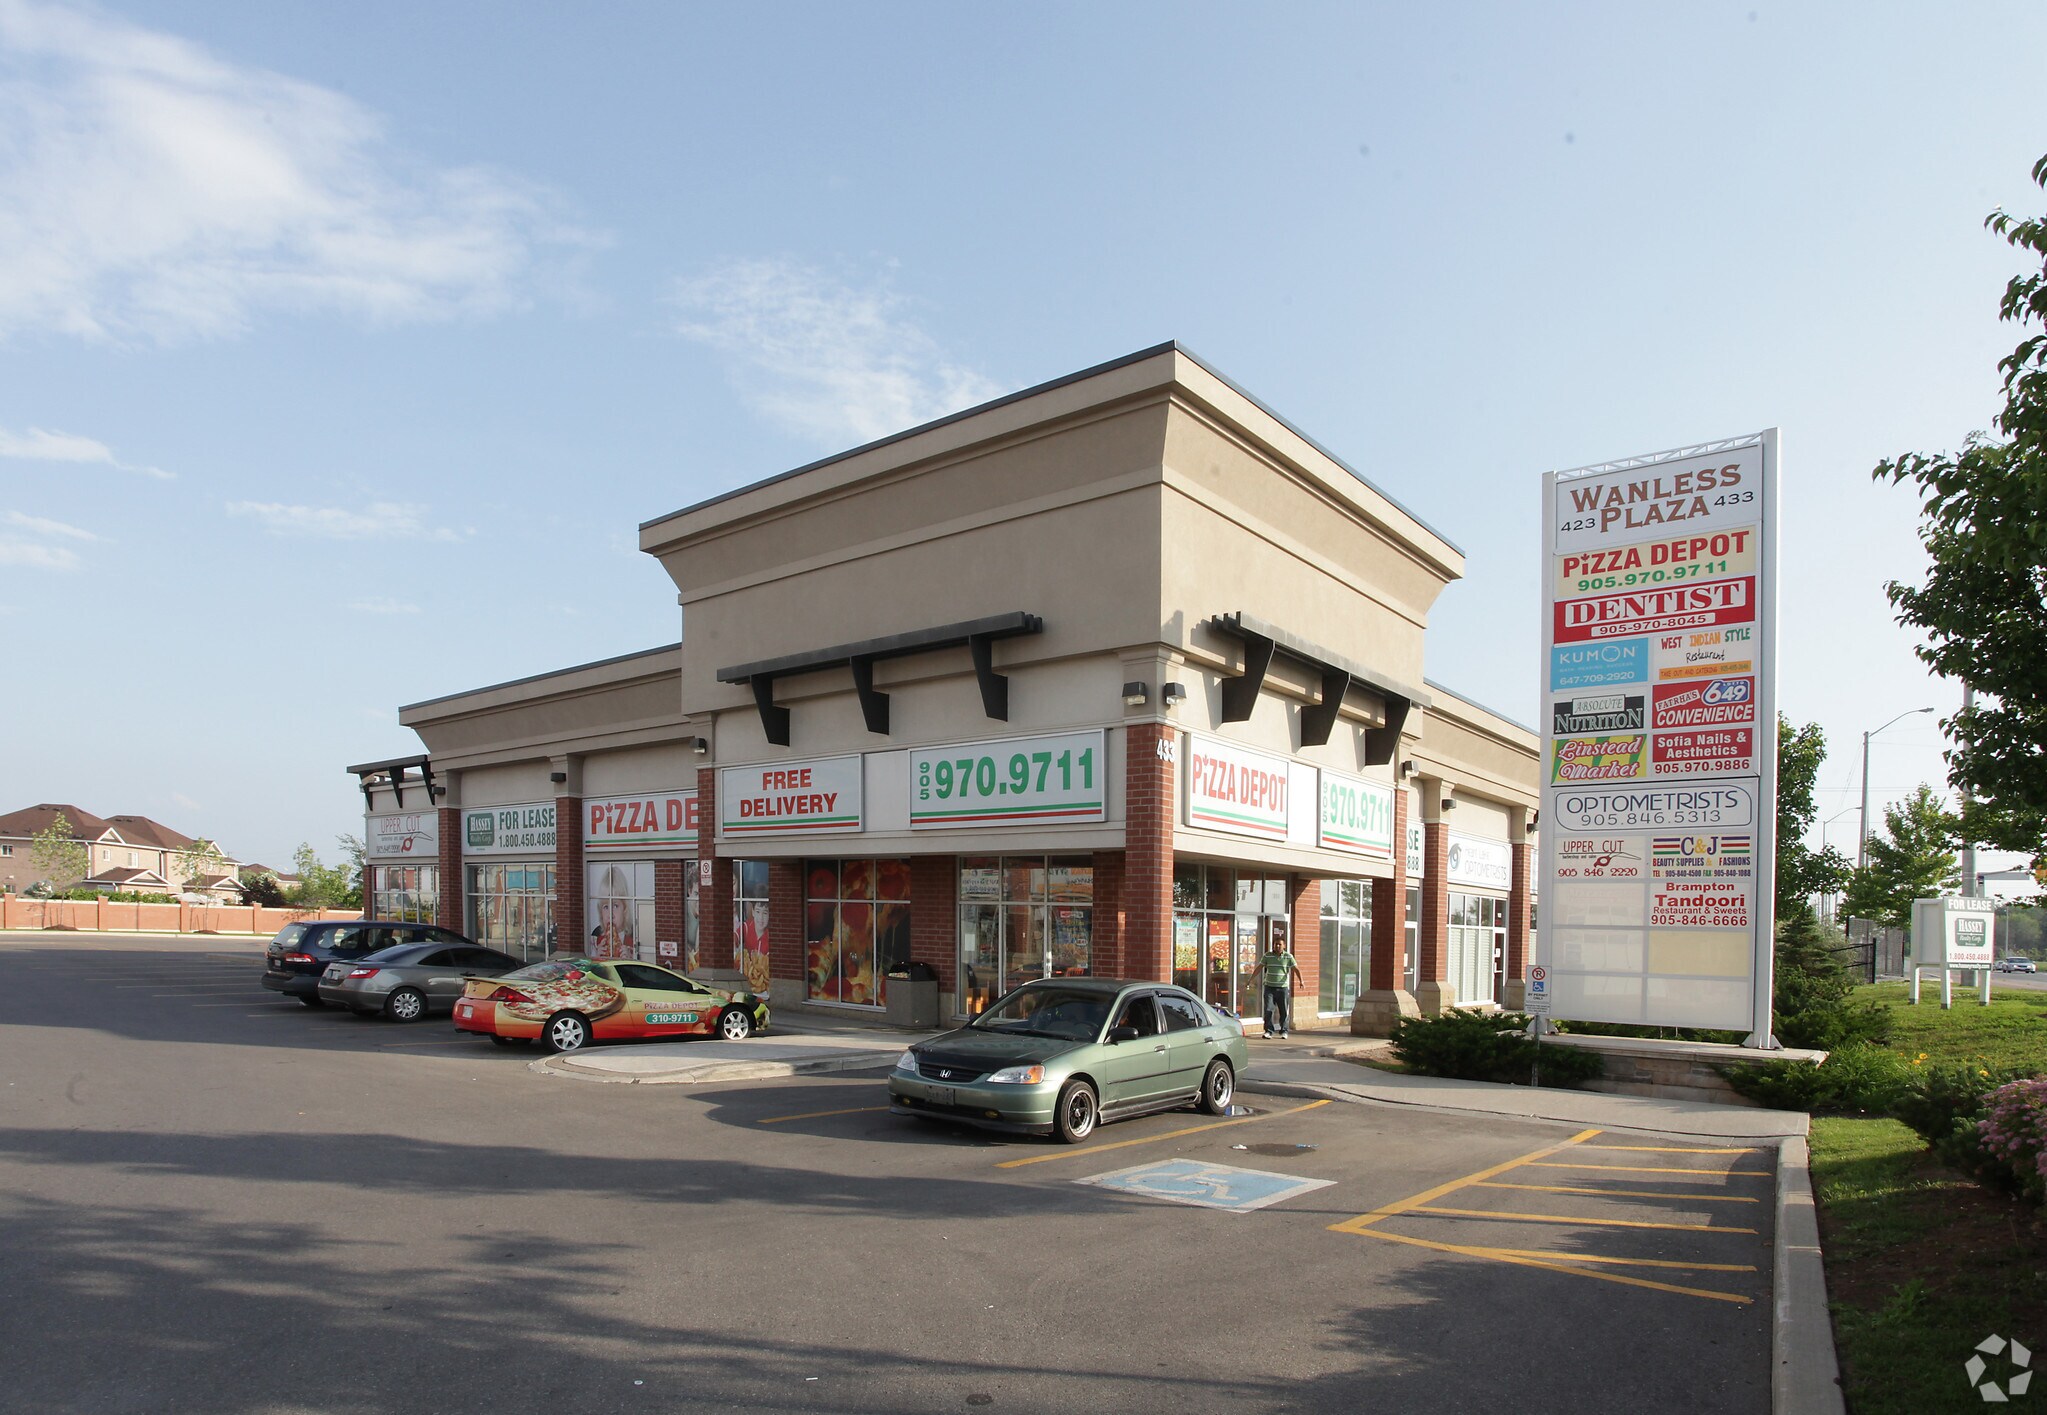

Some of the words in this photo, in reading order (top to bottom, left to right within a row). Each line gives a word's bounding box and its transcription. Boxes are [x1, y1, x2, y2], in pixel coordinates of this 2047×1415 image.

[1570, 464, 1741, 513] WANLESS
[1714, 491, 1754, 507] 433
[1600, 495, 1710, 533] PLAZA
[1561, 518, 1596, 532] 423
[1651, 530, 1750, 566] DEPOT
[1578, 560, 1727, 591] 905.970.9711
[1571, 583, 1740, 624] DENTIST
[1600, 615, 1707, 635] 905-970-8045
[1661, 636, 1682, 650] WEST
[1689, 632, 1721, 647] INDIAN
[1724, 628, 1751, 642] STYLE
[1560, 646, 1636, 664] KUMON
[1560, 671, 1635, 685] 647-709-2920
[1574, 698, 1623, 713] ABSOLUTE
[1555, 708, 1643, 733] NUTRITION
[1656, 704, 1754, 726] CONVENIENCE
[1657, 735, 1692, 748] Sofia
[1697, 733, 1731, 745] Nails
[1736, 731, 1746, 742] &
[1156, 738, 1175, 763] 433
[1557, 736, 1644, 762] Linstead
[1666, 745, 1738, 758] Aesthetics
[935, 748, 1093, 799] 970.9711
[1559, 760, 1640, 780] Market
[1655, 759, 1750, 774] 905.970.9886
[762, 768, 812, 790] FREE
[1240, 766, 1286, 813] DEPOT
[740, 793, 838, 817] DELIVERY
[1566, 790, 1738, 814] OPTOMETRISTS
[381, 817, 401, 833] UPPER
[406, 816, 420, 832] CUT
[499, 811, 519, 830] FOR
[523, 808, 555, 829] LEASE
[1581, 810, 1721, 826] 905.846.5313
[499, 832, 556, 848] 1.800.450.4888
[1563, 840, 1594, 853] UPPER
[1602, 840, 1624, 853] CUT
[1681, 836, 1719, 856] C&J
[1652, 858, 1675, 867] BEAUTY
[1676, 858, 1704, 866] SUPPLIES
[1719, 857, 1751, 866] FASHIONS
[1558, 868, 1577, 877] 905
[1583, 868, 1604, 877] 846
[1610, 867, 1638, 877] 2220
[1666, 882, 1735, 893] Brampton
[1654, 894, 1745, 907] Tandoori
[1948, 899, 1965, 909] FOR
[1967, 900, 1992, 911] LEASE
[1714, 907, 1747, 915] Sweets
[1651, 915, 1747, 926] 905-846-6666
[1958, 919, 1984, 933] HASSEY
[652, 1014, 692, 1023] 310-9711
